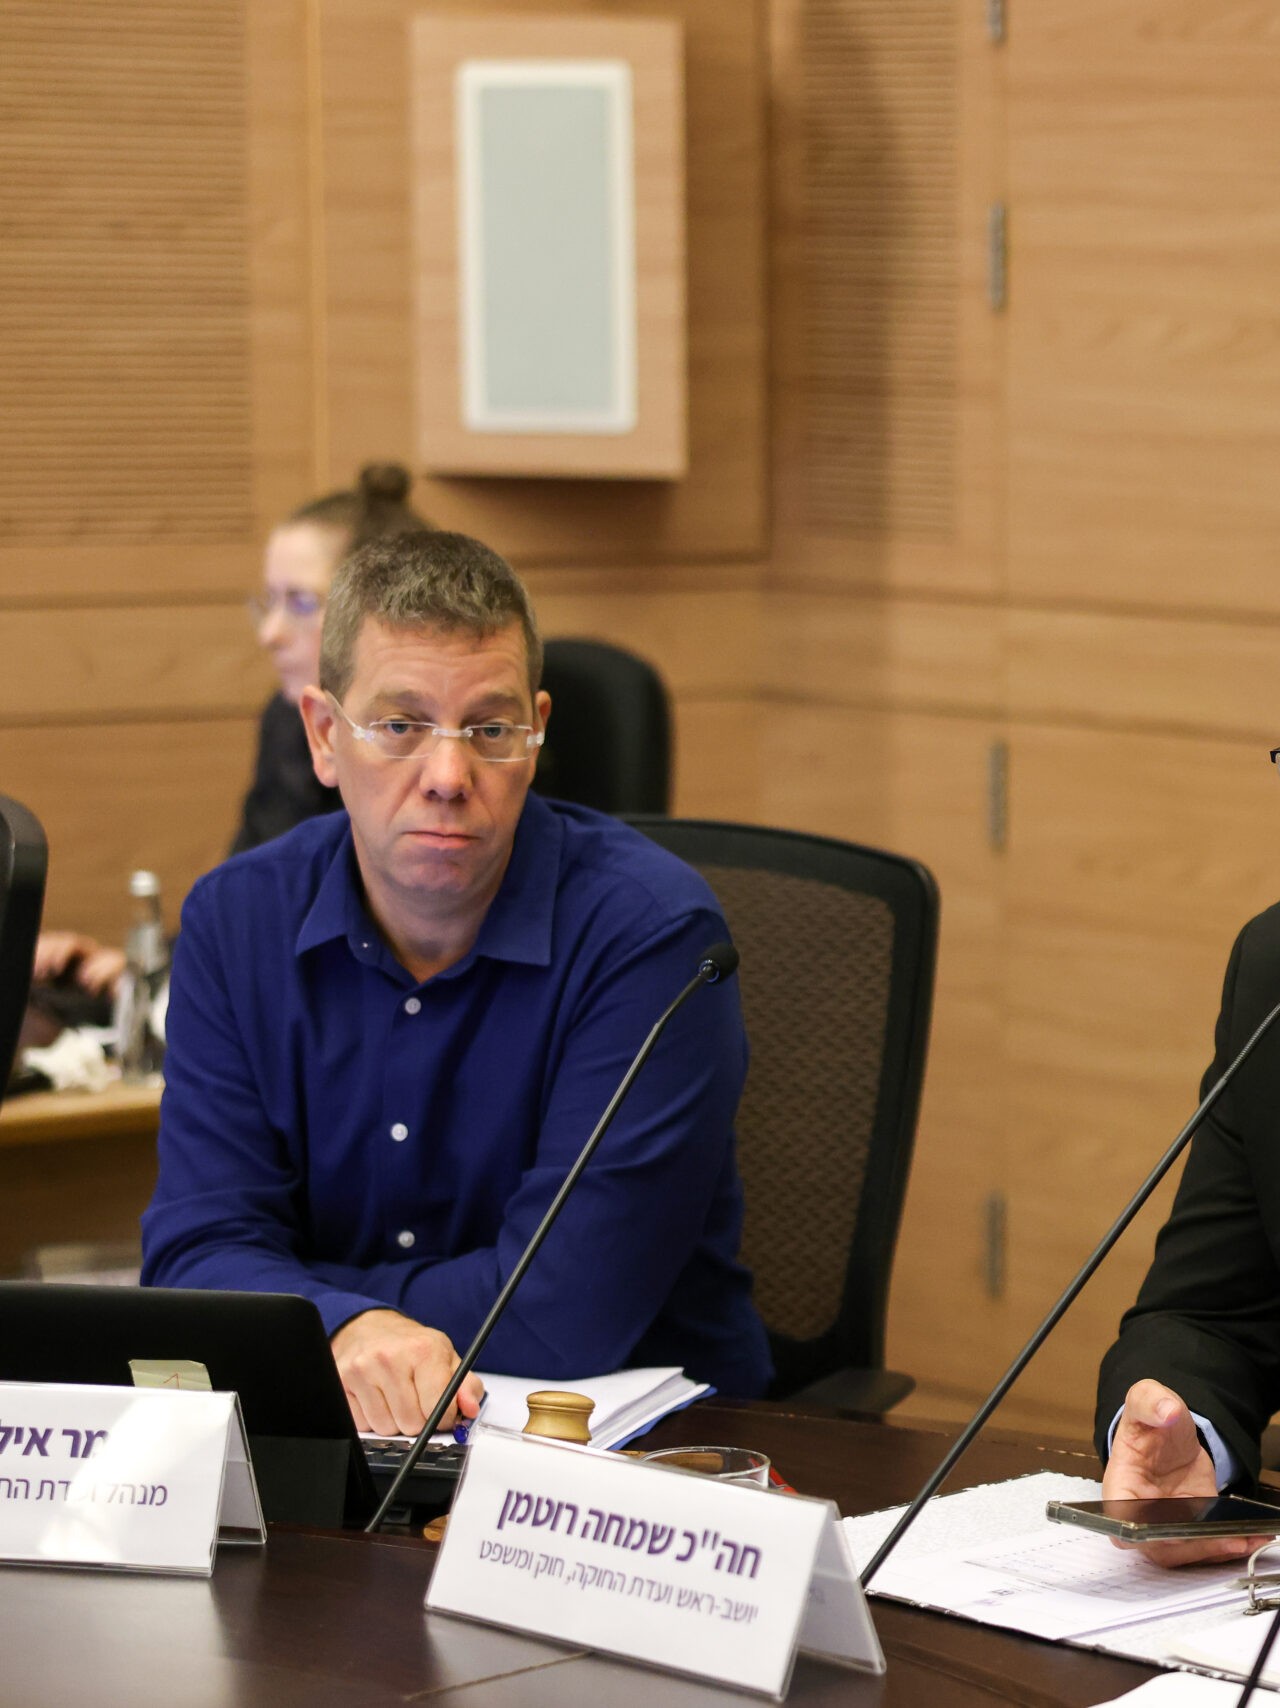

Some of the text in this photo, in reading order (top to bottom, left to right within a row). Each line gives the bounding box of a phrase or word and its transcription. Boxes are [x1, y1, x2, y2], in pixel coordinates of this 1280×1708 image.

[497, 1489, 579, 1535] רוטמן
[581, 1508, 676, 1555] שמחה
[479, 1540, 534, 1570] ומשפט
[533, 1552, 565, 1579] חוק
[627, 1576, 674, 1604] ועדת
